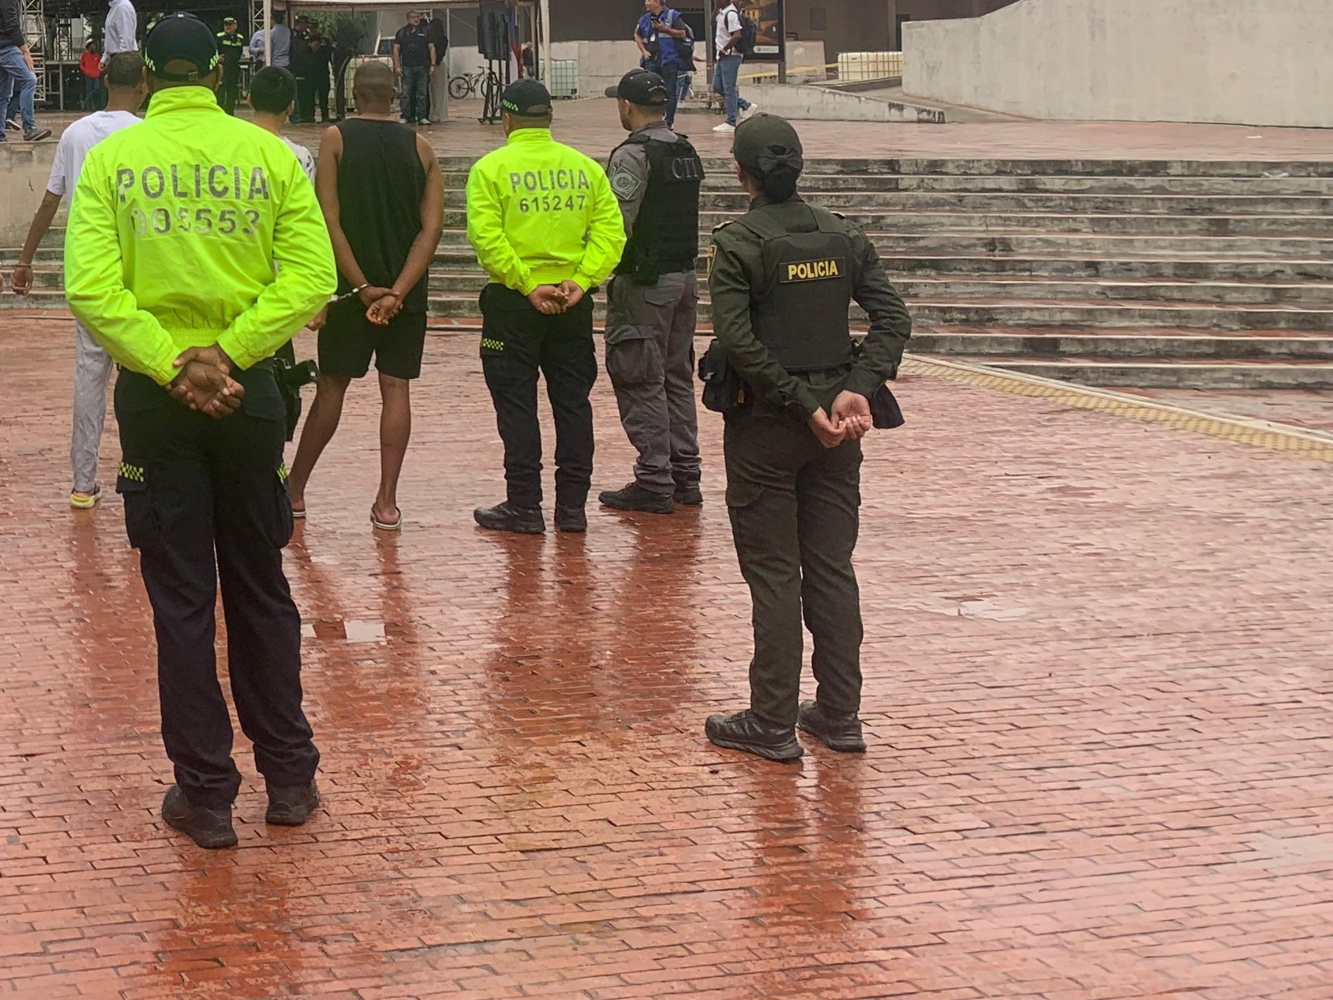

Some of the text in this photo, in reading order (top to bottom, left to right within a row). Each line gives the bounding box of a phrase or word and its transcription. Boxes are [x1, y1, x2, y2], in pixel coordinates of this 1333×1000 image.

[671, 157, 699, 178] CTI
[116, 164, 270, 203] POLICIA
[510, 169, 590, 193] POLICIA
[519, 194, 586, 213] 615247
[788, 260, 838, 280] POLICIA
